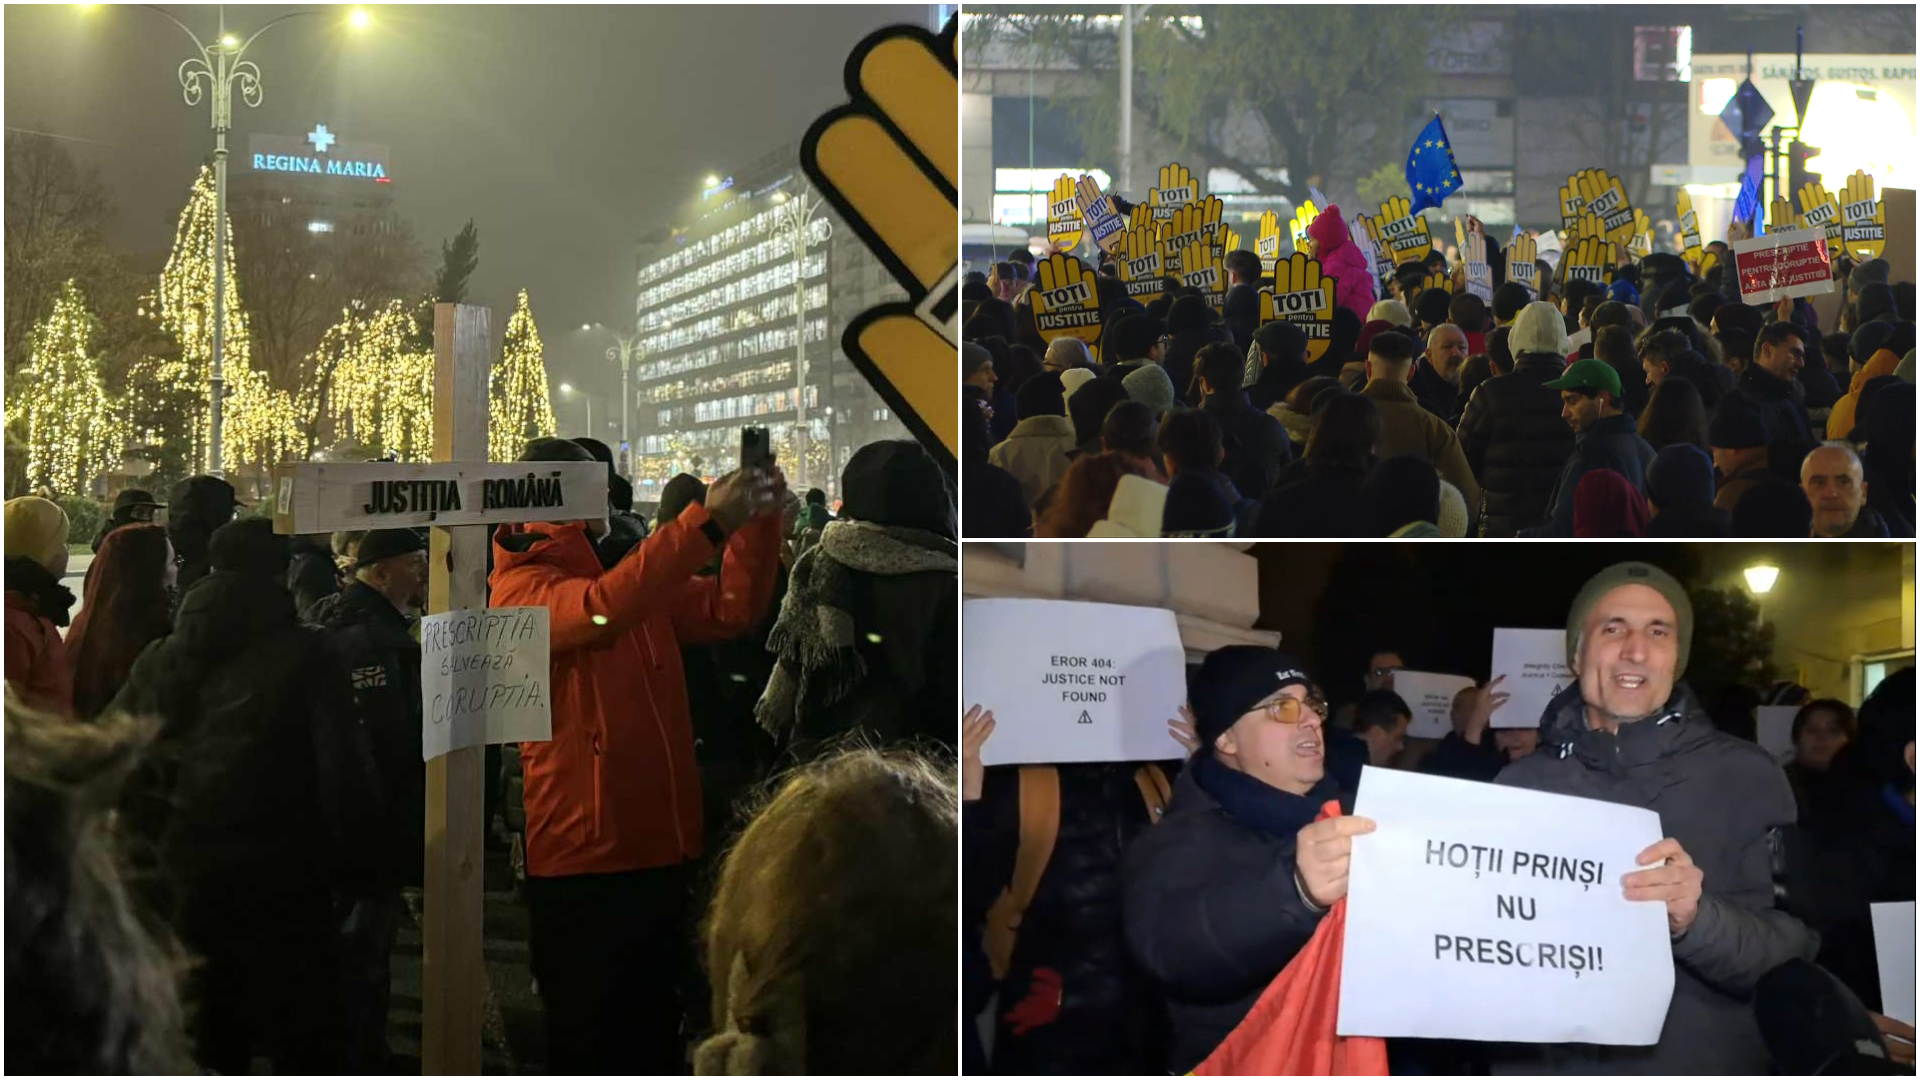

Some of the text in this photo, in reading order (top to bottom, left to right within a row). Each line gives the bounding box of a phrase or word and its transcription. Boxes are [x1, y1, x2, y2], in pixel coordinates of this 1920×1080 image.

[253, 153, 385, 178] REGINA MARIA
[1059, 304, 1083, 313] pentru
[1040, 311, 1100, 331] JUSTIȚIE
[364, 471, 564, 522] JUSTIȚIA ROMÂNĂ
[1051, 655, 1116, 669] EROR 404:
[1041, 673, 1127, 686] JUSTICE NOT
[1062, 691, 1107, 702] FOUND
[1425, 839, 1604, 892] HOȚII PRINȘI
[1497, 894, 1537, 921] NU
[1434, 933, 1604, 979] PRESCRIȘI!
